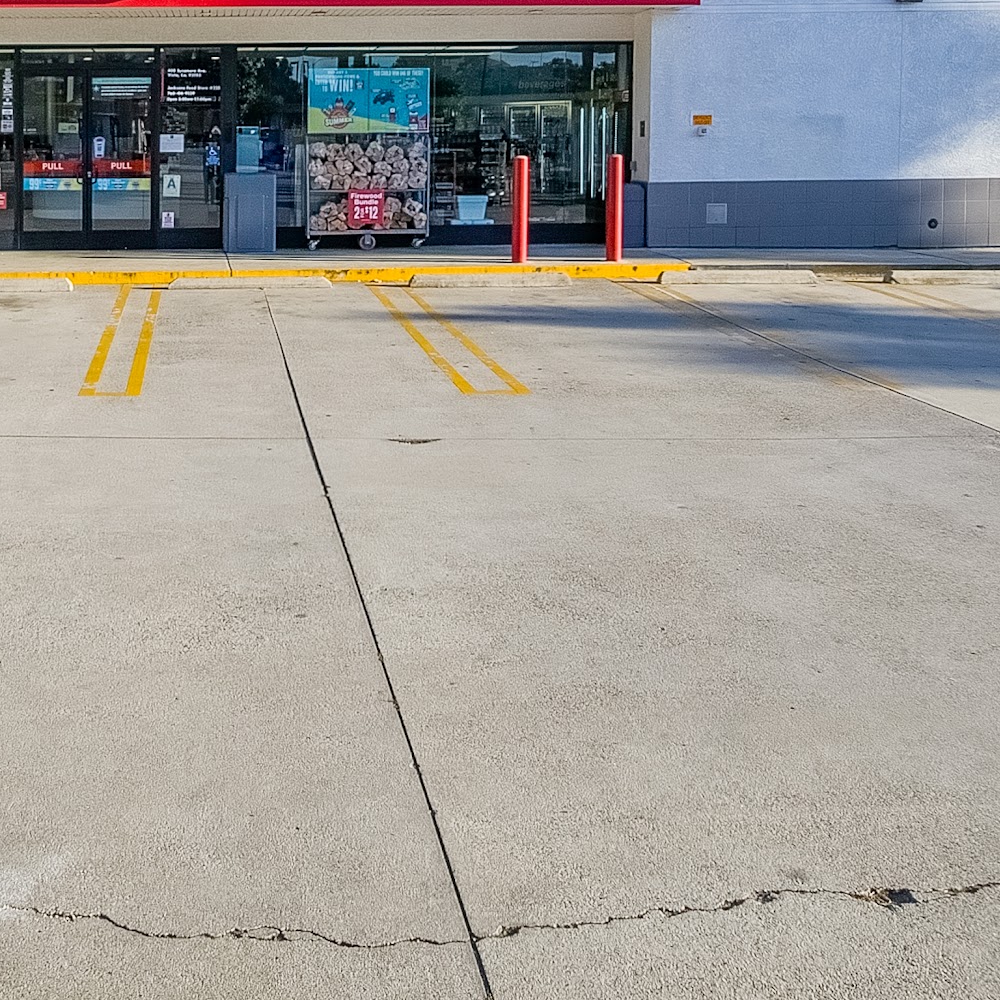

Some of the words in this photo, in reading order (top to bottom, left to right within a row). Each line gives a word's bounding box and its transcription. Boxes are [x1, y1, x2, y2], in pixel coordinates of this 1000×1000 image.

[329, 79, 354, 92] WIN!
[42, 162, 64, 171] PULL
[110, 161, 133, 170] PULL
[167, 178, 176, 189] A
[350, 192, 383, 200] Firewood
[353, 205, 360, 220] 2
